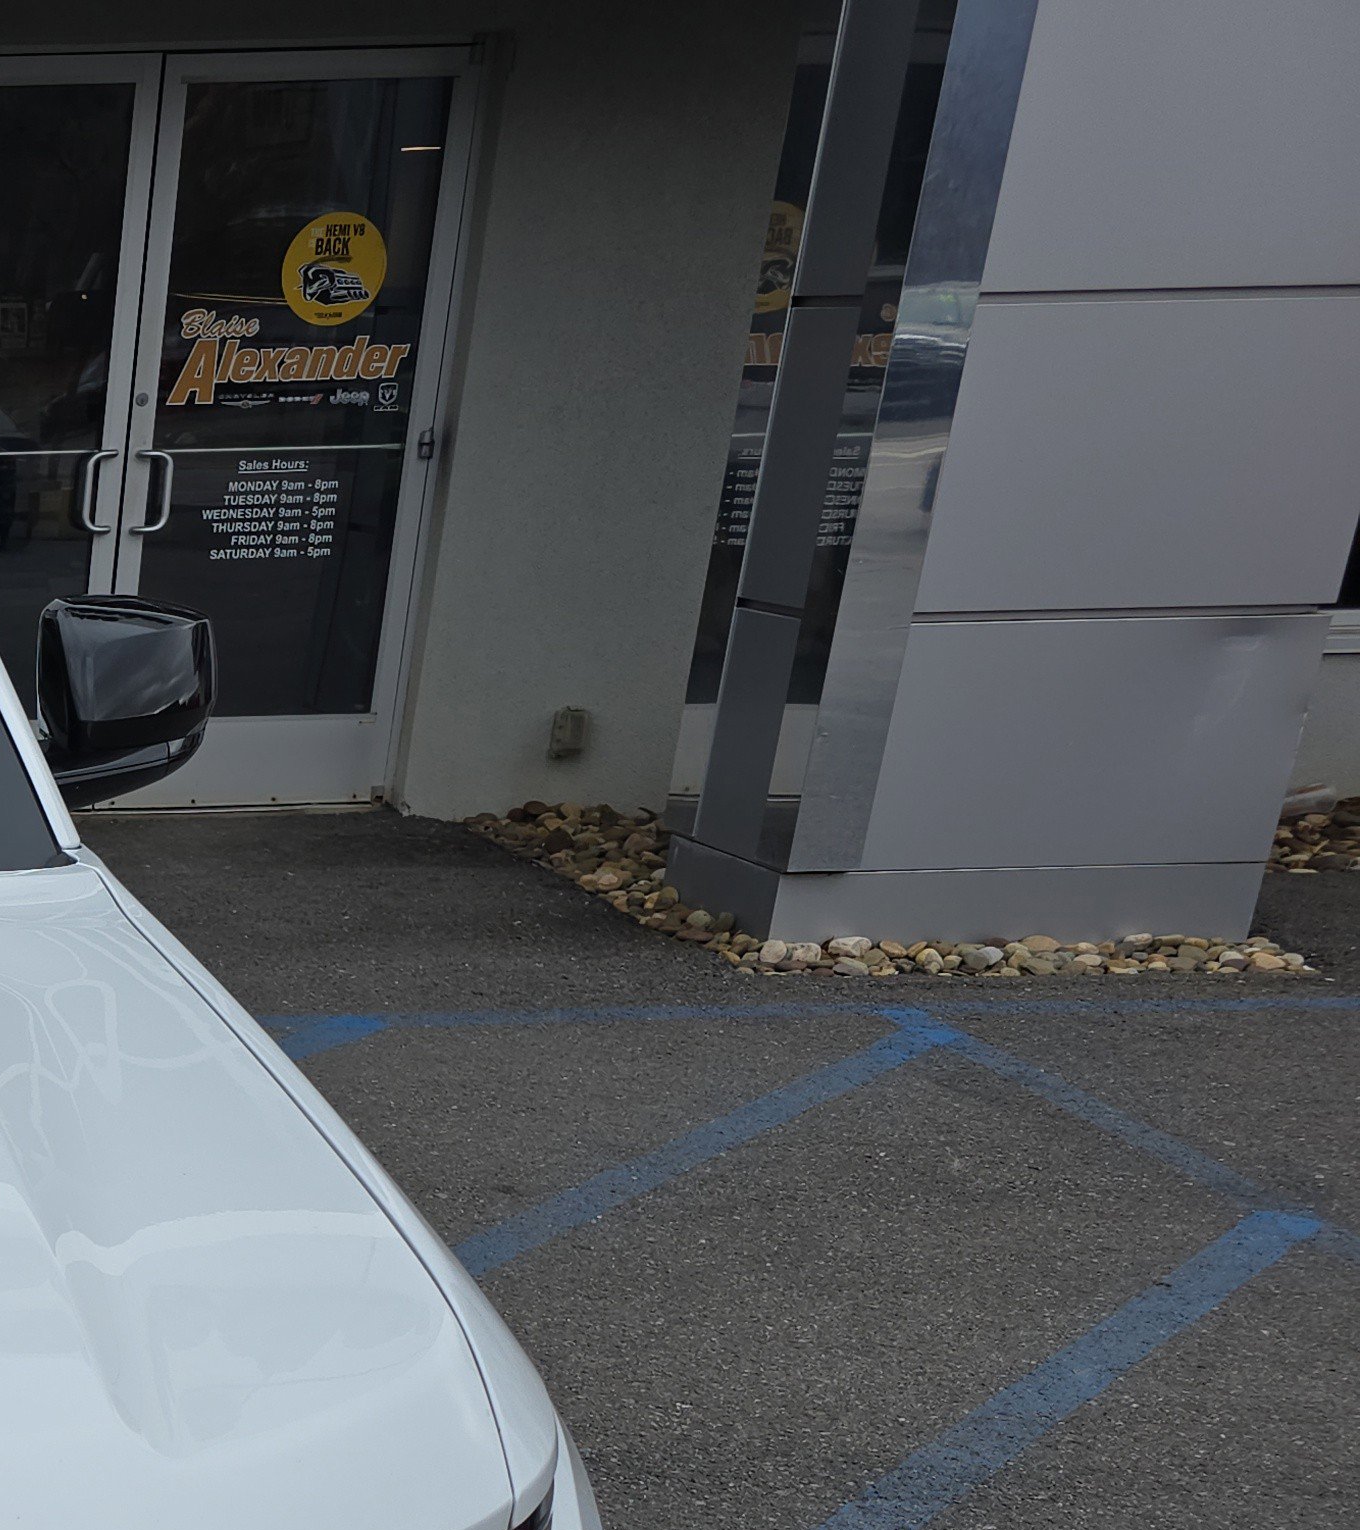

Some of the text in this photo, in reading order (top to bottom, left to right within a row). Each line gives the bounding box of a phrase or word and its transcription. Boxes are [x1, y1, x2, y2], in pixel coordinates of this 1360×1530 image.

[325, 224, 350, 237] HEMI
[353, 223, 365, 236] V8
[315, 237, 351, 255] BACK
[180, 308, 260, 340] Blaise
[165, 335, 411, 406] Alexander
[238, 459, 309, 470] Sales Hours:
[228, 480, 280, 492] MONDAY
[281, 480, 305, 490] 9am
[314, 479, 339, 491] 8pm
[223, 494, 278, 506] TUESDAY
[280, 493, 304, 504] 9am
[313, 493, 338, 504] 8pm
[202, 508, 276, 520] WEDNESDAY
[278, 507, 302, 517] 9am
[311, 506, 336, 517] 5pm
[212, 521, 274, 533] THURSDAY
[277, 520, 300, 531] 9am
[309, 520, 334, 531] 8pm
[231, 535, 273, 546] FRIDAY
[275, 534, 299, 544] 9am
[308, 533, 333, 544] 8pm
[209, 548, 272, 560] SATURDAY
[274, 547, 297, 558] 9am
[307, 546, 331, 558] 5pm
